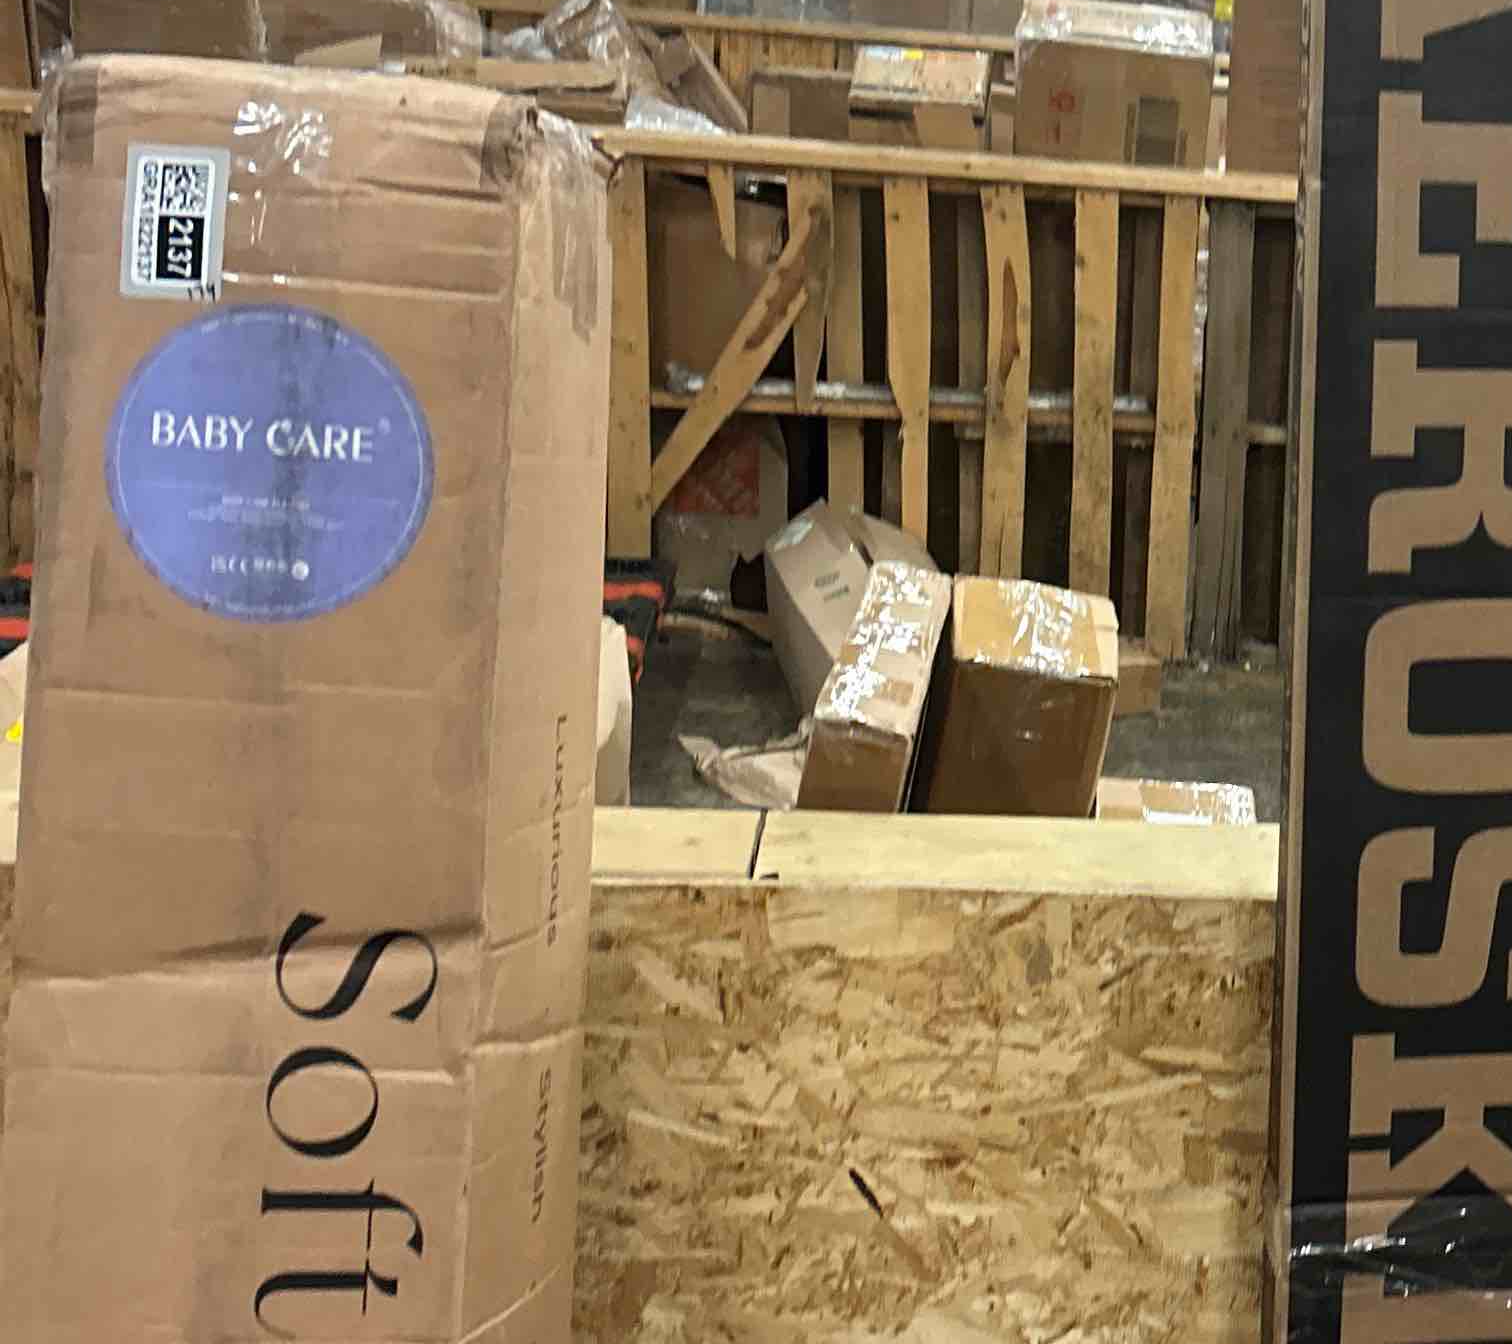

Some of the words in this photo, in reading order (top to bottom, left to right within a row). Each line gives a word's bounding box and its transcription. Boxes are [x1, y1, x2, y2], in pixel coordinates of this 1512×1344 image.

[166, 217, 195, 278] 2137
[151, 410, 254, 453] BABY
[266, 418, 374, 464] CARE
[547, 713, 568, 949] Luxurious
[253, 911, 438, 1342] Soft
[531, 1066, 554, 1225] Stylish
